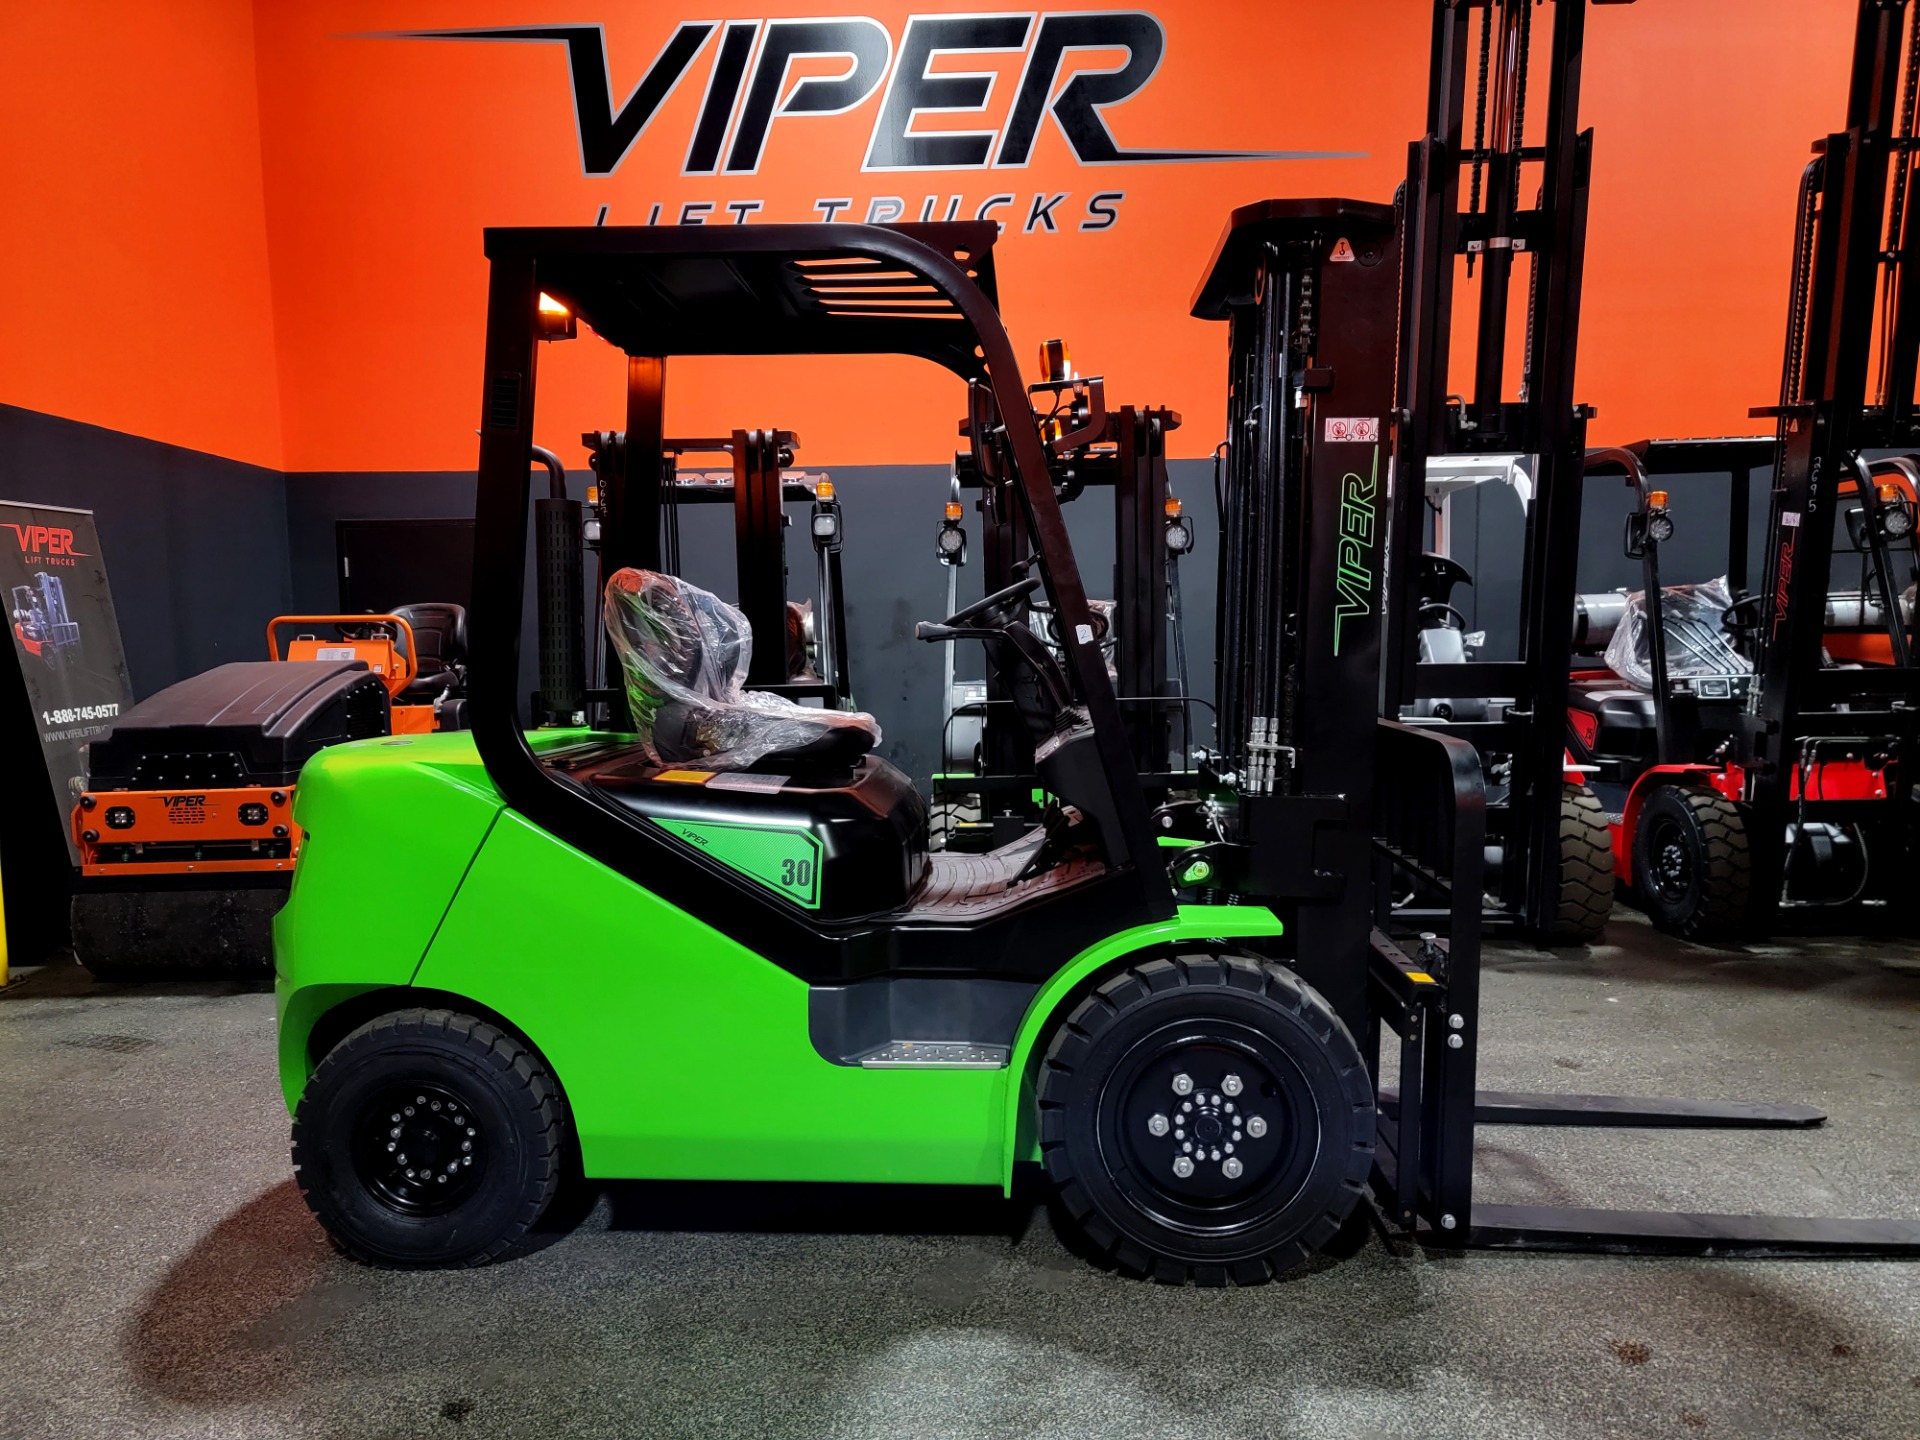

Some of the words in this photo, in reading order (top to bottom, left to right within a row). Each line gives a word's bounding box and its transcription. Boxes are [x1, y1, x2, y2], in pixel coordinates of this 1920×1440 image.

[430, 9, 1250, 178] VIPER
[4, 523, 86, 556] VIPER
[1334, 444, 1379, 656] VIPER
[24, 556, 41, 564] LIFT
[45, 557, 75, 566] TRUCKS
[1773, 528, 1796, 640] VIPER
[42, 703, 119, 725] 1-888-745-0577
[155, 794, 212, 807] VIPER
[681, 827, 709, 846] VIPER
[781, 858, 811, 887] 30
